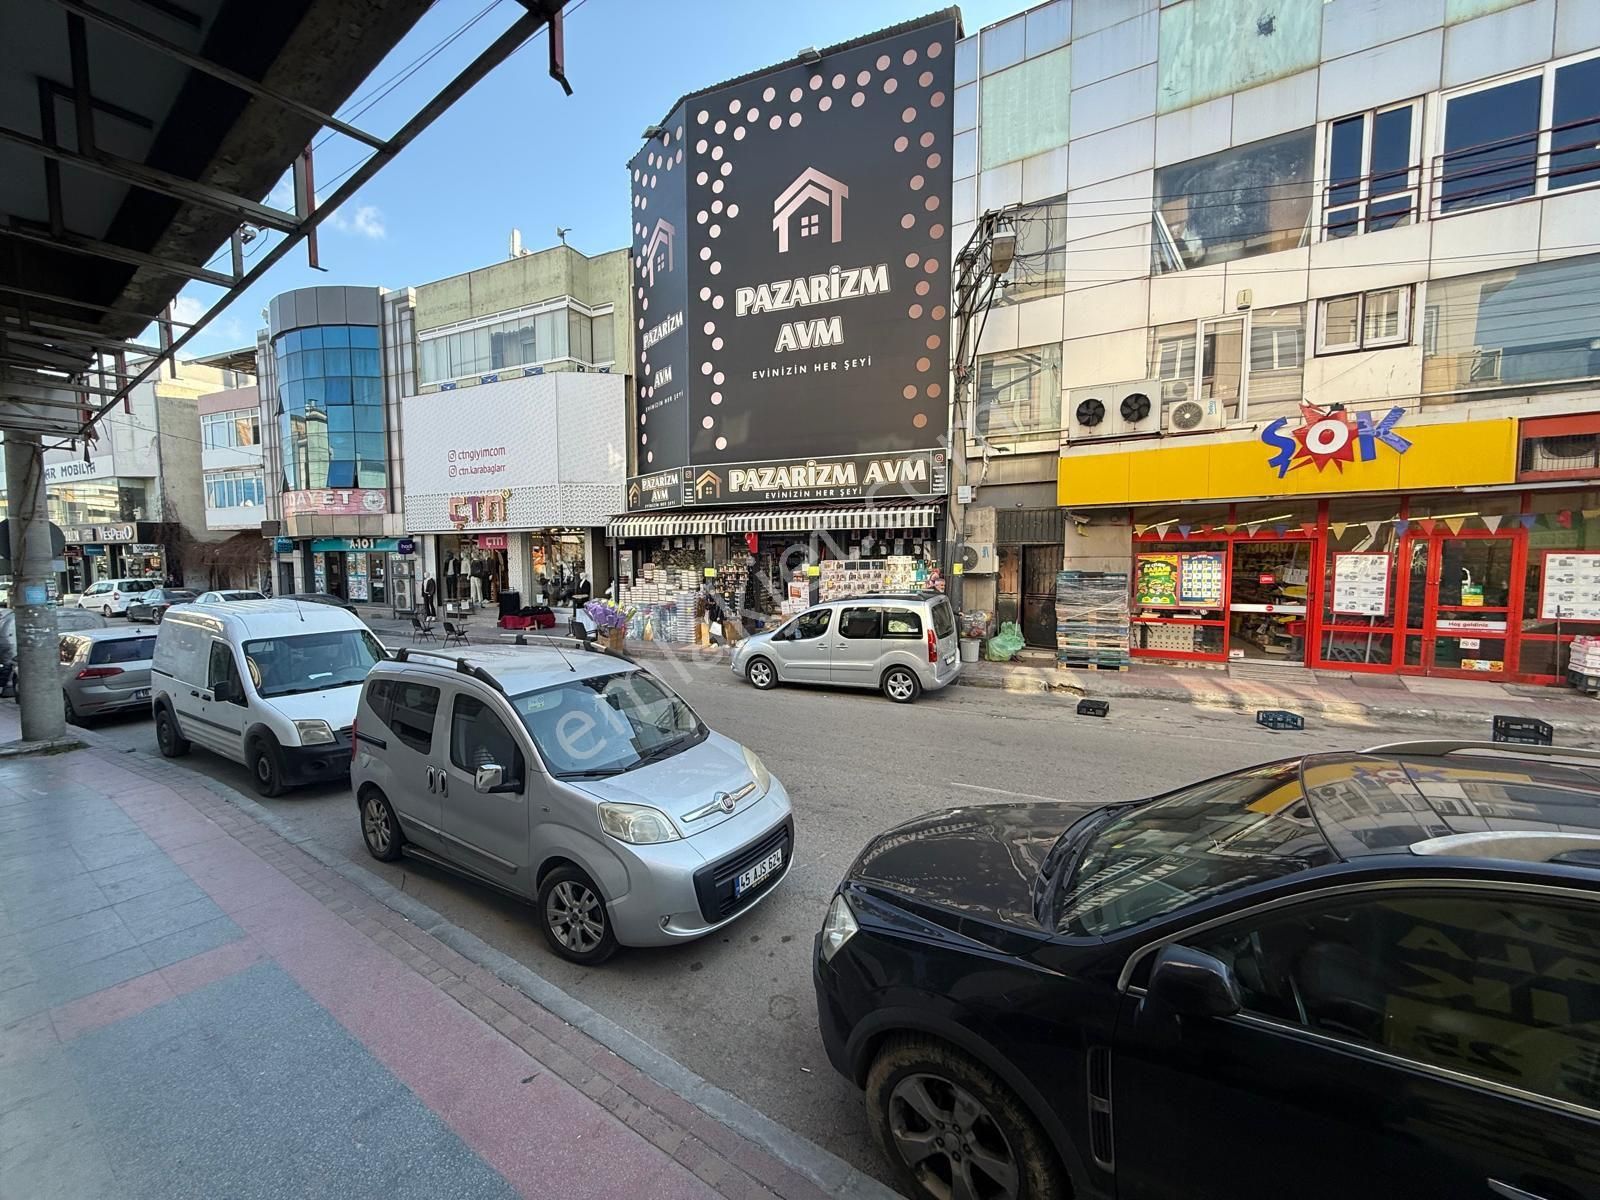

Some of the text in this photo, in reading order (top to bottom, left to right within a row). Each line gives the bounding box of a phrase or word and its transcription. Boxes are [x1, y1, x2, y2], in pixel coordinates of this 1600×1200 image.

[735, 263, 891, 317] PAZARİZM
[643, 311, 684, 351] PAZARİZM
[774, 316, 844, 353] AVM
[654, 365, 672, 389] AVM
[752, 355, 872, 380] EVİNİZİN HER ŞEYİ
[1261, 405, 1413, 479] ŞOK
[641, 472, 679, 491] PAZARİZM
[728, 460, 858, 492] PAZARİZM
[863, 459, 927, 485] AVM
[651, 488, 669, 502] AVM
[765, 487, 862, 499] EVİNİZİN HER ŞEYİ
[740, 872, 750, 888] 45
